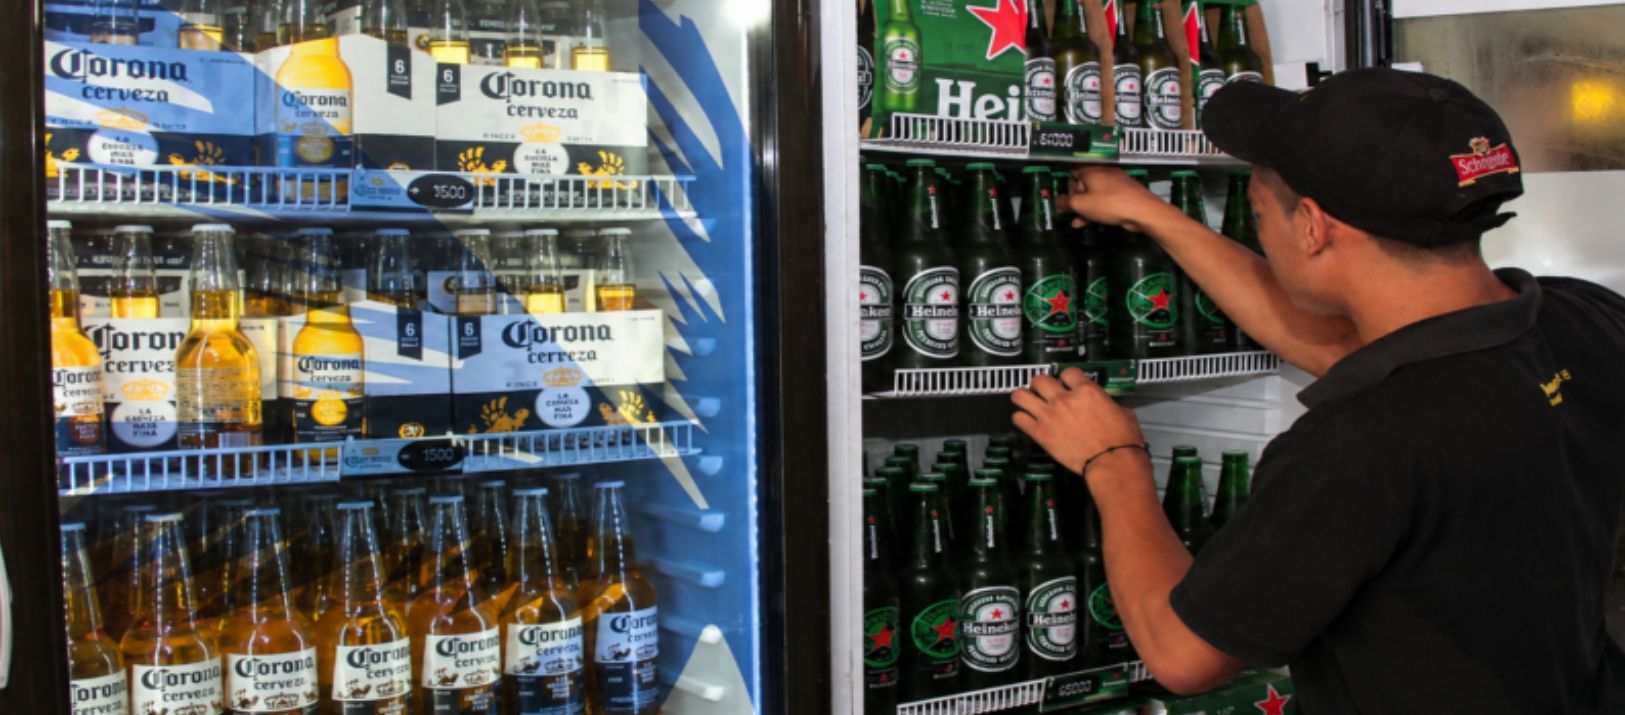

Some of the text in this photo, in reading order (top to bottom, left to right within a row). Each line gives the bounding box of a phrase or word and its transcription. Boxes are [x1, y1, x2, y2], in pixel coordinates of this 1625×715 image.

[49, 47, 189, 84] Corona
[394, 59, 405, 75] 6
[443, 68, 454, 83] 6
[81, 84, 169, 104] cerveza
[480, 70, 593, 104] Corona
[281, 91, 349, 110] Corona
[506, 103, 578, 119] cerveza
[404, 322, 416, 337] 6
[463, 322, 475, 336] 6
[501, 318, 614, 352] Corona
[298, 356, 360, 374] Corona
[527, 350, 598, 365] cerveza
[235, 655, 314, 680] Corona
[141, 664, 221, 693] Corona
